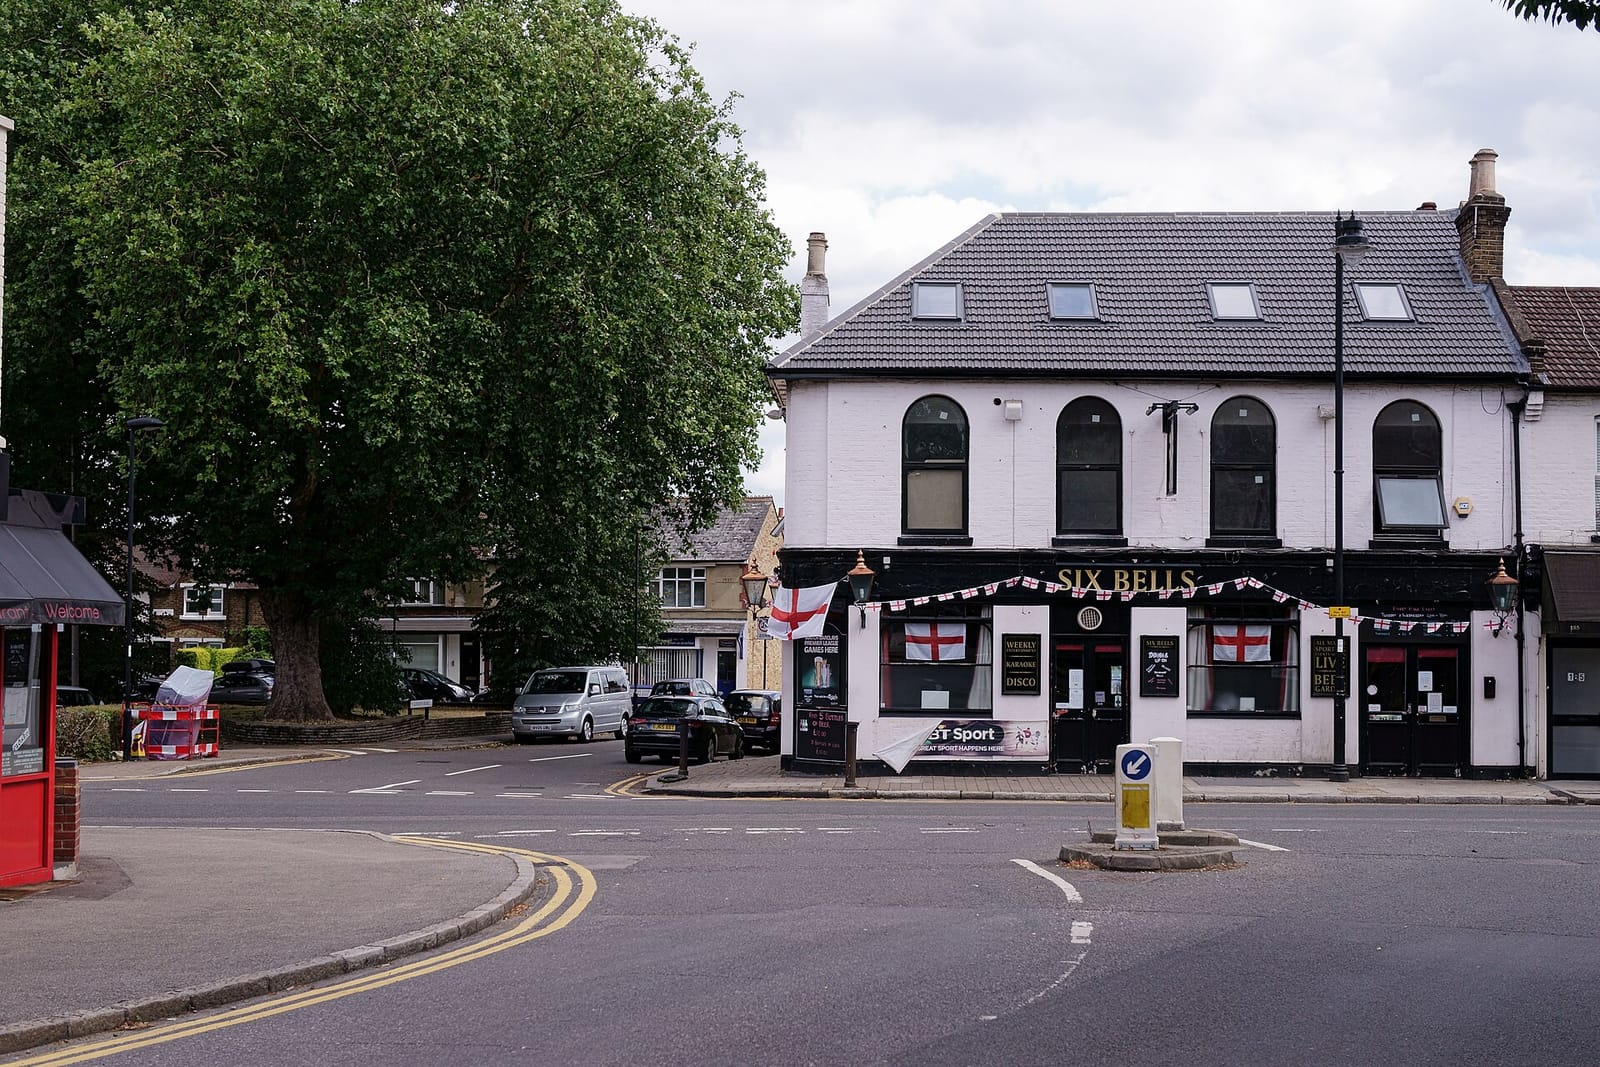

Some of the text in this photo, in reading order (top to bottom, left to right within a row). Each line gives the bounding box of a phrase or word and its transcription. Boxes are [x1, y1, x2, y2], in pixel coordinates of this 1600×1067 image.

[1058, 569, 1196, 592] SIX BELLS
[0, 603, 100, 619] rant Welcome
[804, 646, 839, 654] GAMES HERE
[1006, 641, 1037, 649] WEEKLY
[1006, 677, 1036, 687] DISCO
[1314, 674, 1337, 685] BEE
[928, 728, 995, 742] BT Sport
